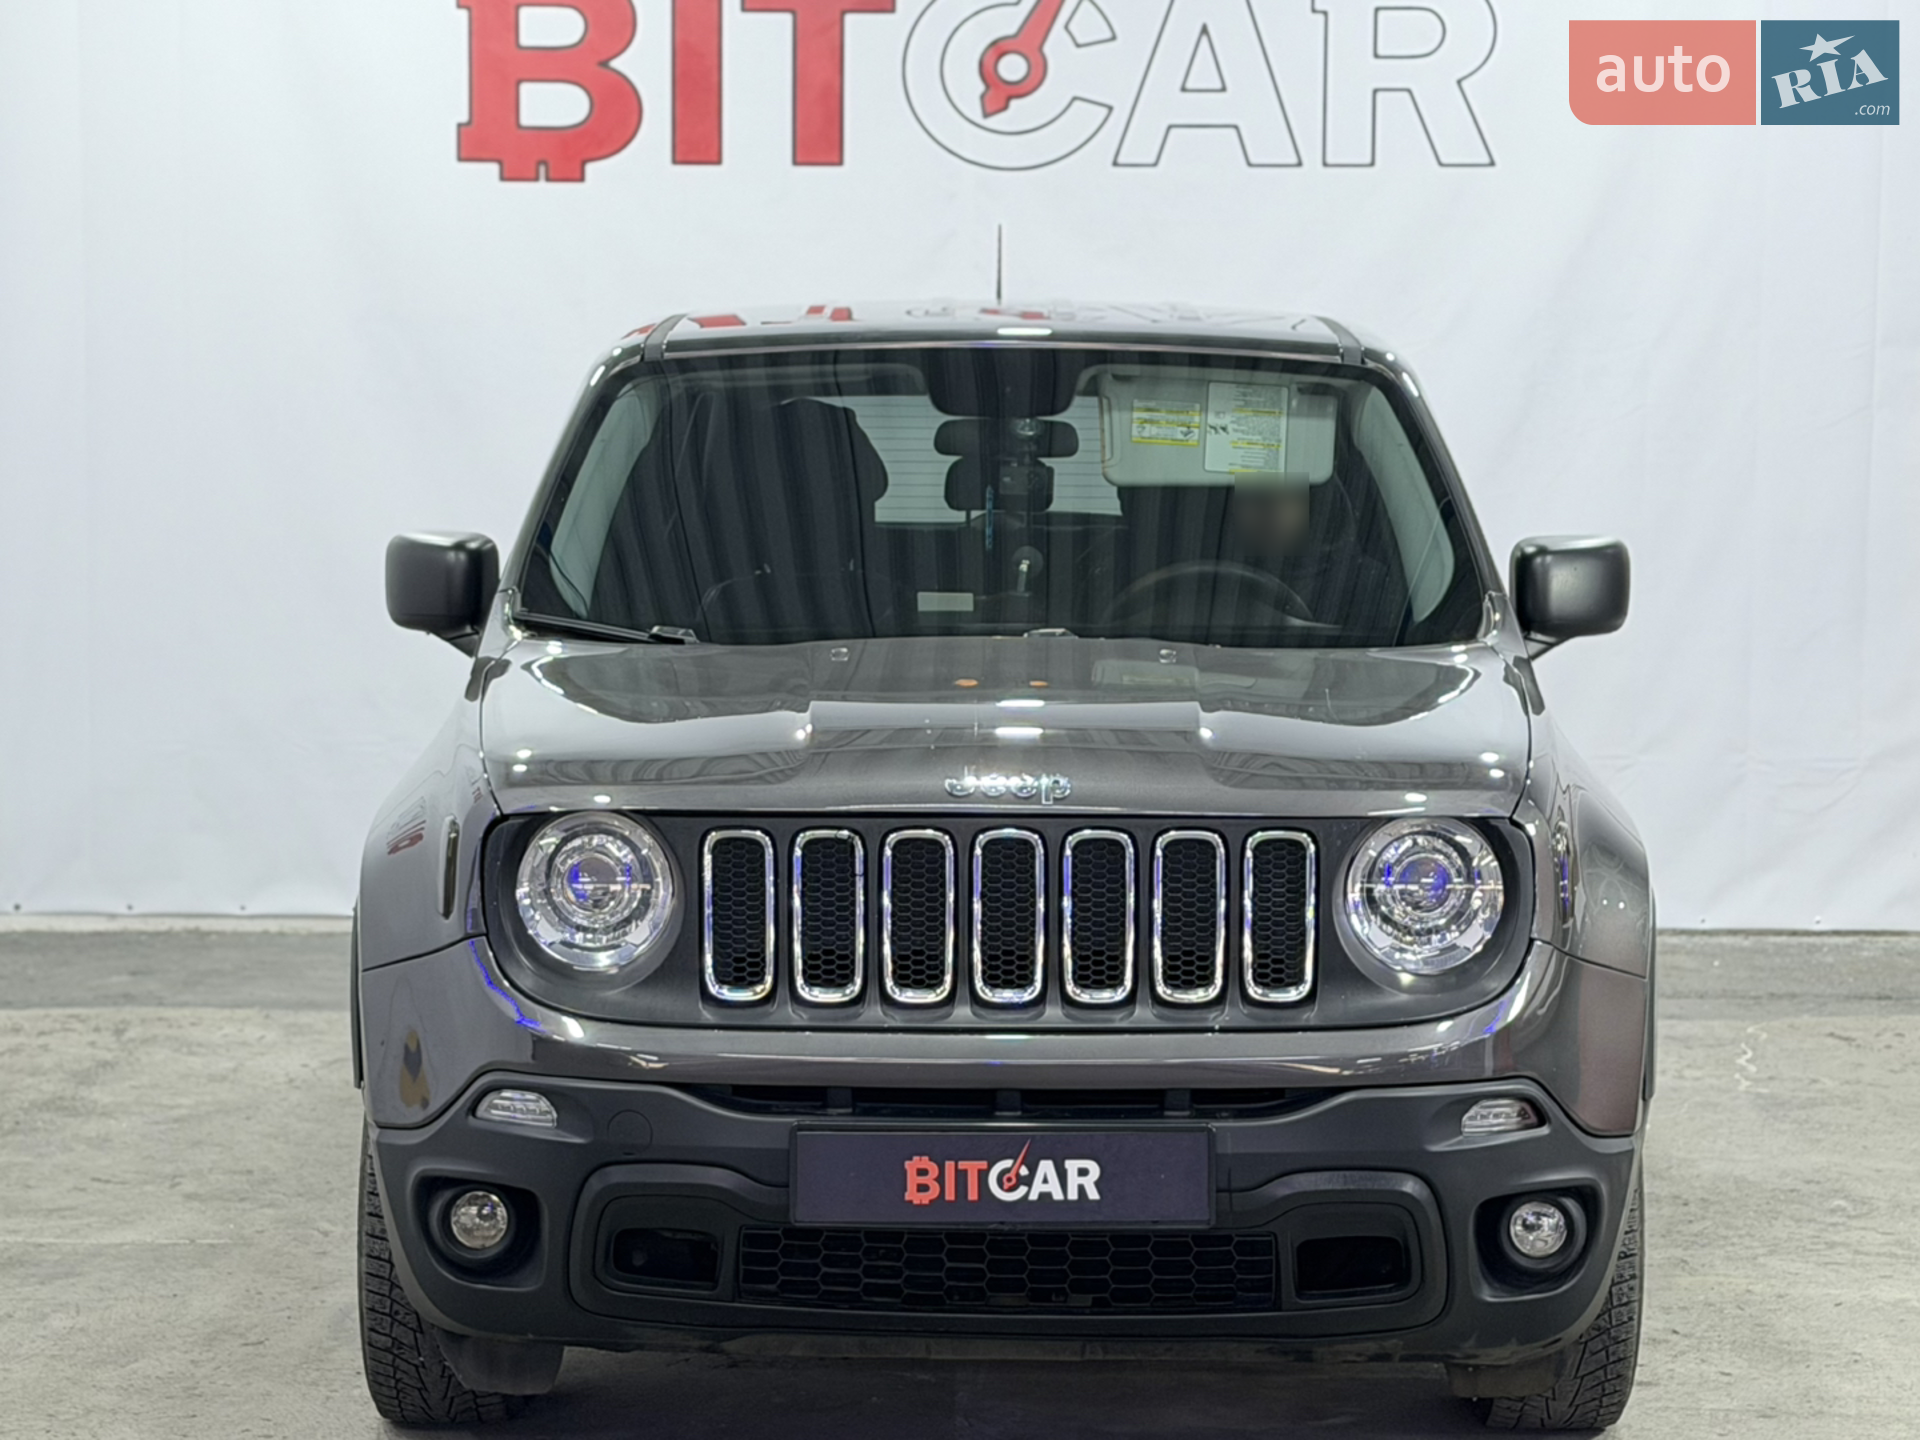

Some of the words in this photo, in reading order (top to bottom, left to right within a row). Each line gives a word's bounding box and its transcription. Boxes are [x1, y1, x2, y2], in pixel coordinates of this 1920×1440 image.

[457, 0, 1497, 182] BITCAR
[944, 767, 1071, 804] Jeep
[904, 1150, 1101, 1204] BITCAR
